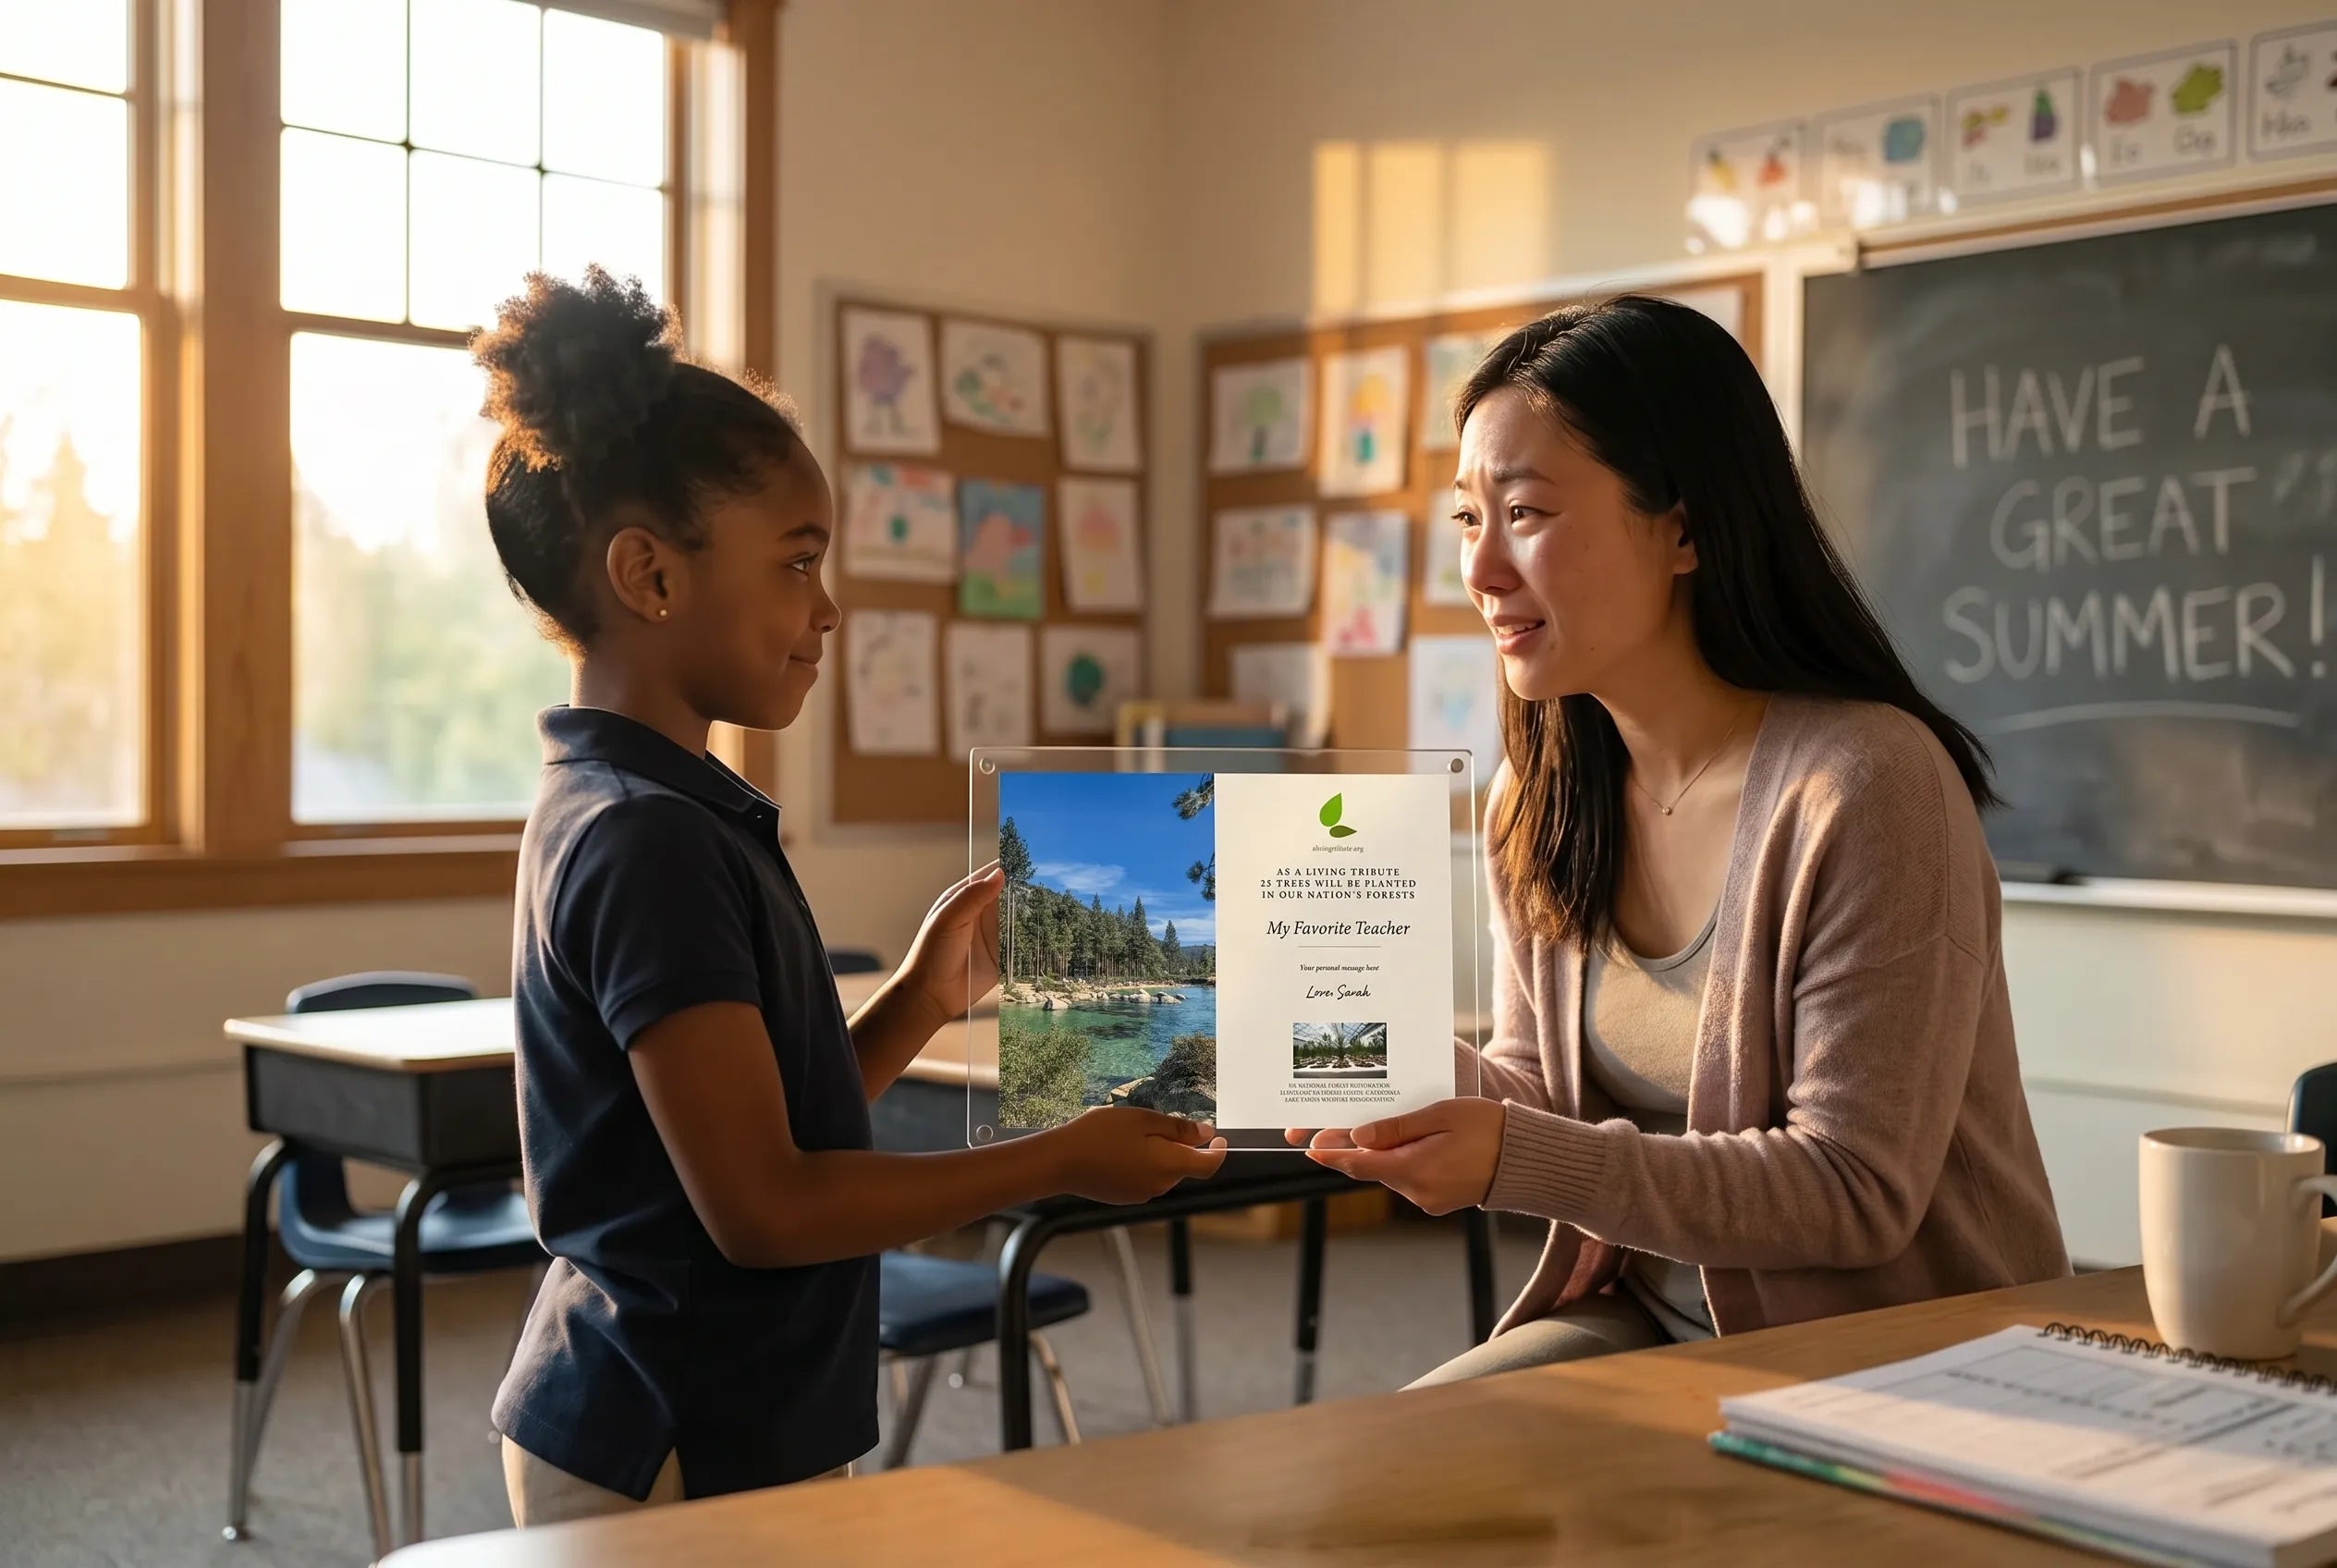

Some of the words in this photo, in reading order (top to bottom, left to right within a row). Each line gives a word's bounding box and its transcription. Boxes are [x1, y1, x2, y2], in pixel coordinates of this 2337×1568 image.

[1949, 355, 2146, 469] HAVE
[2192, 342, 2254, 439] A
[1988, 465, 2258, 572] GREAT
[1943, 554, 2328, 684] SUMMER!
[1277, 867, 1291, 876] AS
[1294, 867, 1302, 876] A
[1305, 867, 1346, 876] LIVING
[1350, 867, 1400, 876] TRIBUTE
[1260, 879, 1272, 888] 25
[1276, 879, 1311, 888] TREES
[1315, 879, 1343, 888] WILL
[1347, 879, 1361, 888] BE
[1364, 879, 1416, 888] PLANTED
[1262, 890, 1275, 899] IN
[1279, 890, 1303, 899] OUR
[1307, 890, 1362, 899] NATION'S
[1366, 890, 1415, 899] FORESTS
[1266, 921, 1291, 939] My
[1293, 921, 1352, 935] Favorite
[1355, 920, 1411, 935] Teacher
[1337, 984, 1371, 999] Sarah
